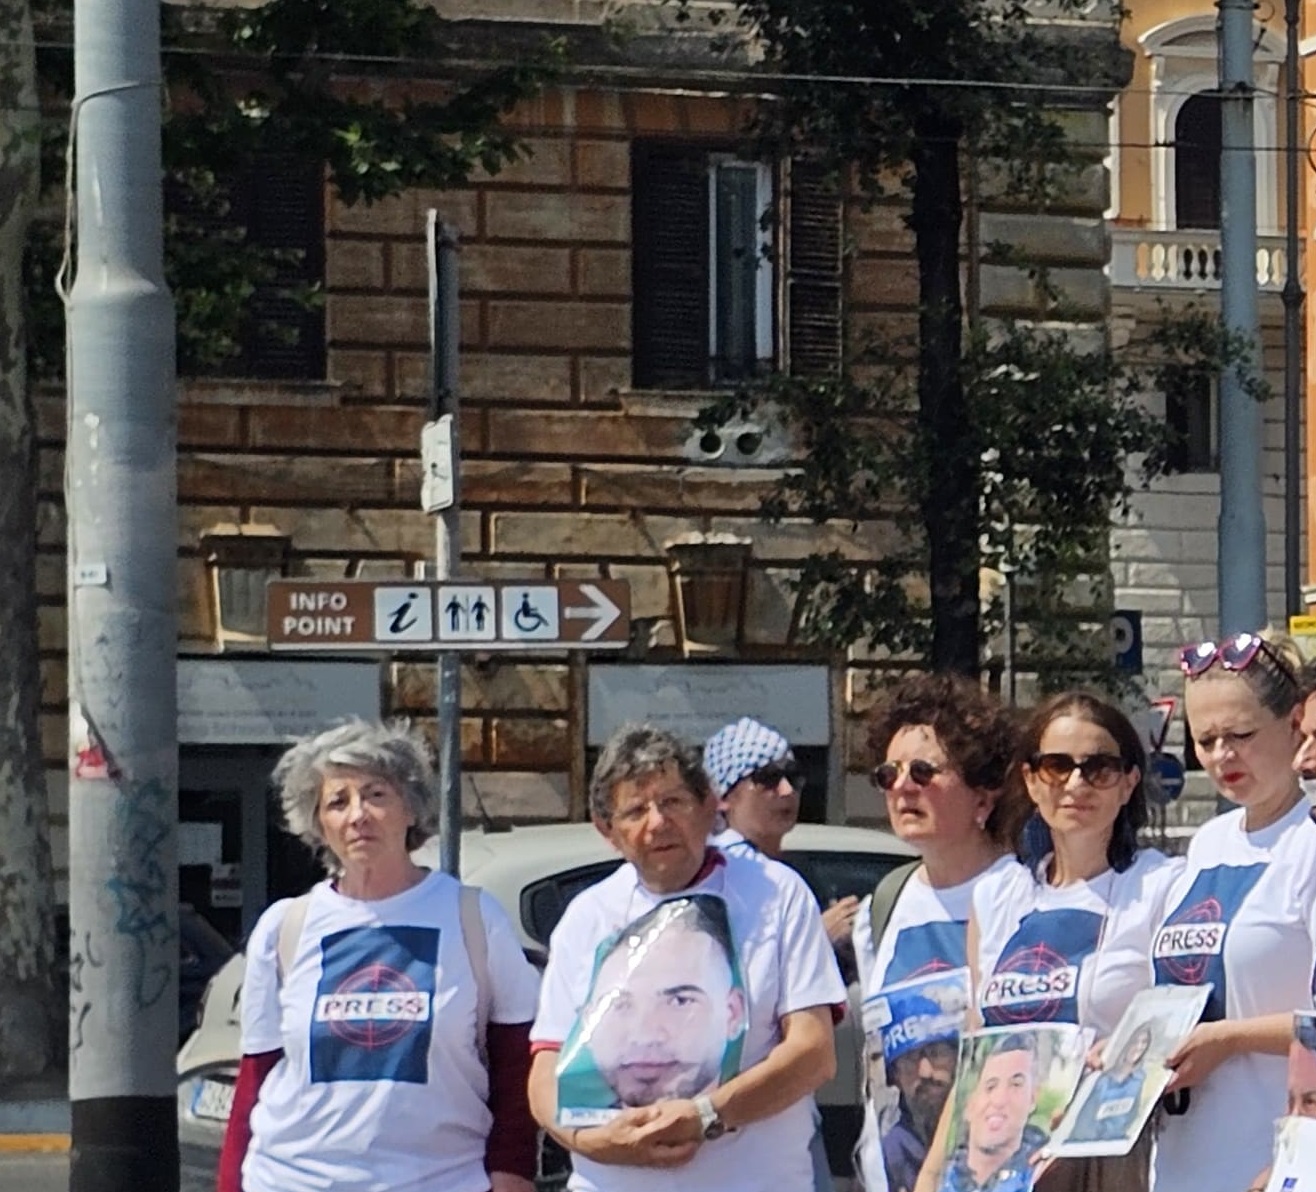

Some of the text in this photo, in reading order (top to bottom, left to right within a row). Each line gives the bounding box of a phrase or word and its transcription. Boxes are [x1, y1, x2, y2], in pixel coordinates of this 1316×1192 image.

[290, 591, 347, 612] INFO
[282, 615, 356, 636] POINT
[1158, 927, 1220, 953] PRESS
[984, 971, 1071, 1001] PRESS
[324, 998, 424, 1014] PRESS
